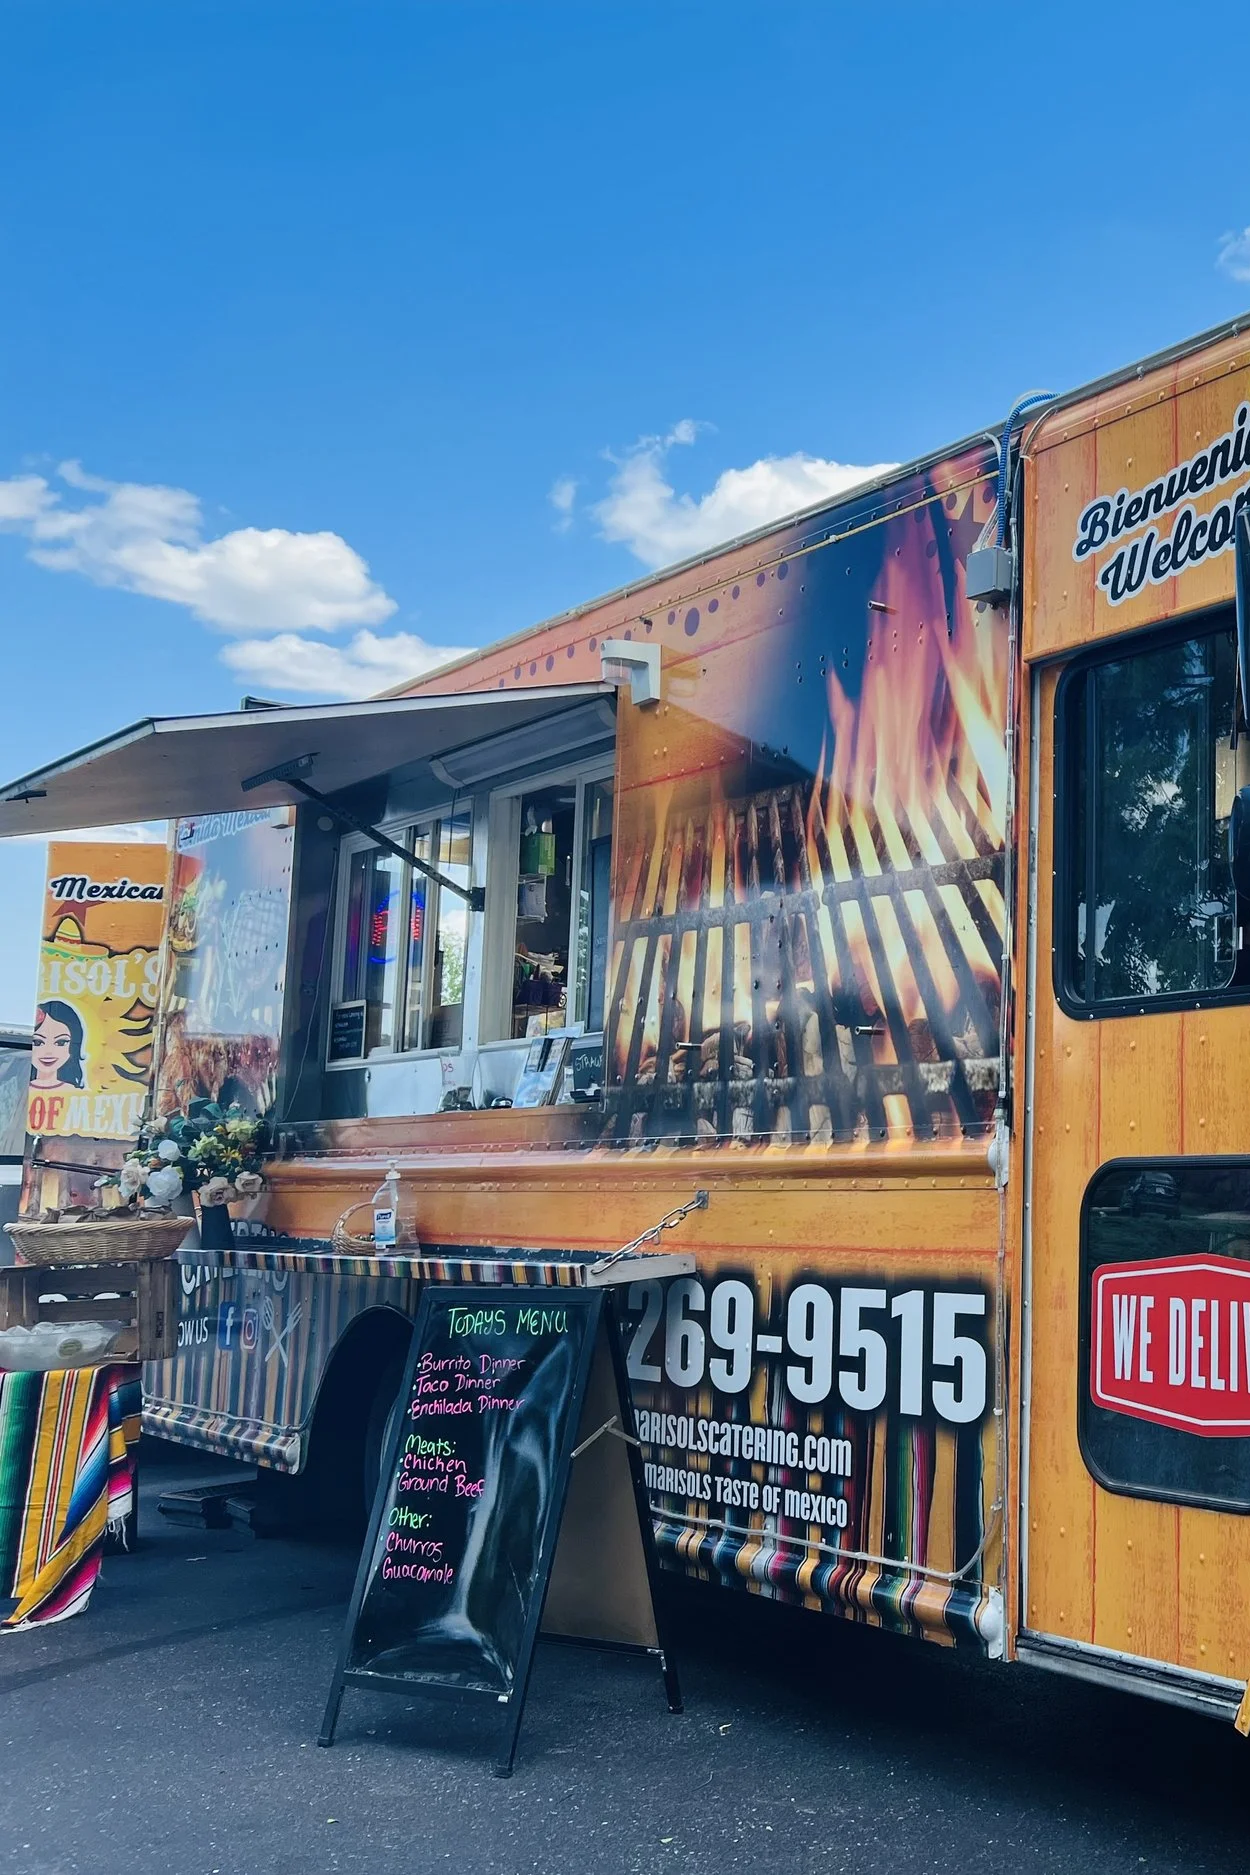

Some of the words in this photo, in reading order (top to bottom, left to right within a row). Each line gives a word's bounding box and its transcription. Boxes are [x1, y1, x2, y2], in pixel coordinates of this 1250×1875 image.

[28, 1096, 64, 1132] OF
[63, 1091, 145, 1134] MEXI
[196, 1316, 209, 1345] US
[448, 1307, 506, 1339] TODAYS
[516, 1308, 569, 1336] MENU
[626, 1278, 987, 1424] 269-9515
[1112, 1294, 1155, 1383] WE
[419, 1352, 472, 1374] Burrito
[479, 1354, 527, 1376] Dinner
[416, 1374, 450, 1396] Taco
[454, 1373, 501, 1392] Dinner
[411, 1398, 473, 1420] Enchilada
[477, 1395, 526, 1414] Dinner
[405, 1434, 457, 1457] Meats:
[403, 1453, 468, 1474] Chicken
[397, 1471, 449, 1493] Ground
[454, 1474, 486, 1498] Beef
[762, 1484, 781, 1514] OF
[388, 1506, 433, 1529] Other:
[386, 1532, 443, 1563] Churros
[382, 1557, 454, 1585] Guacamole
